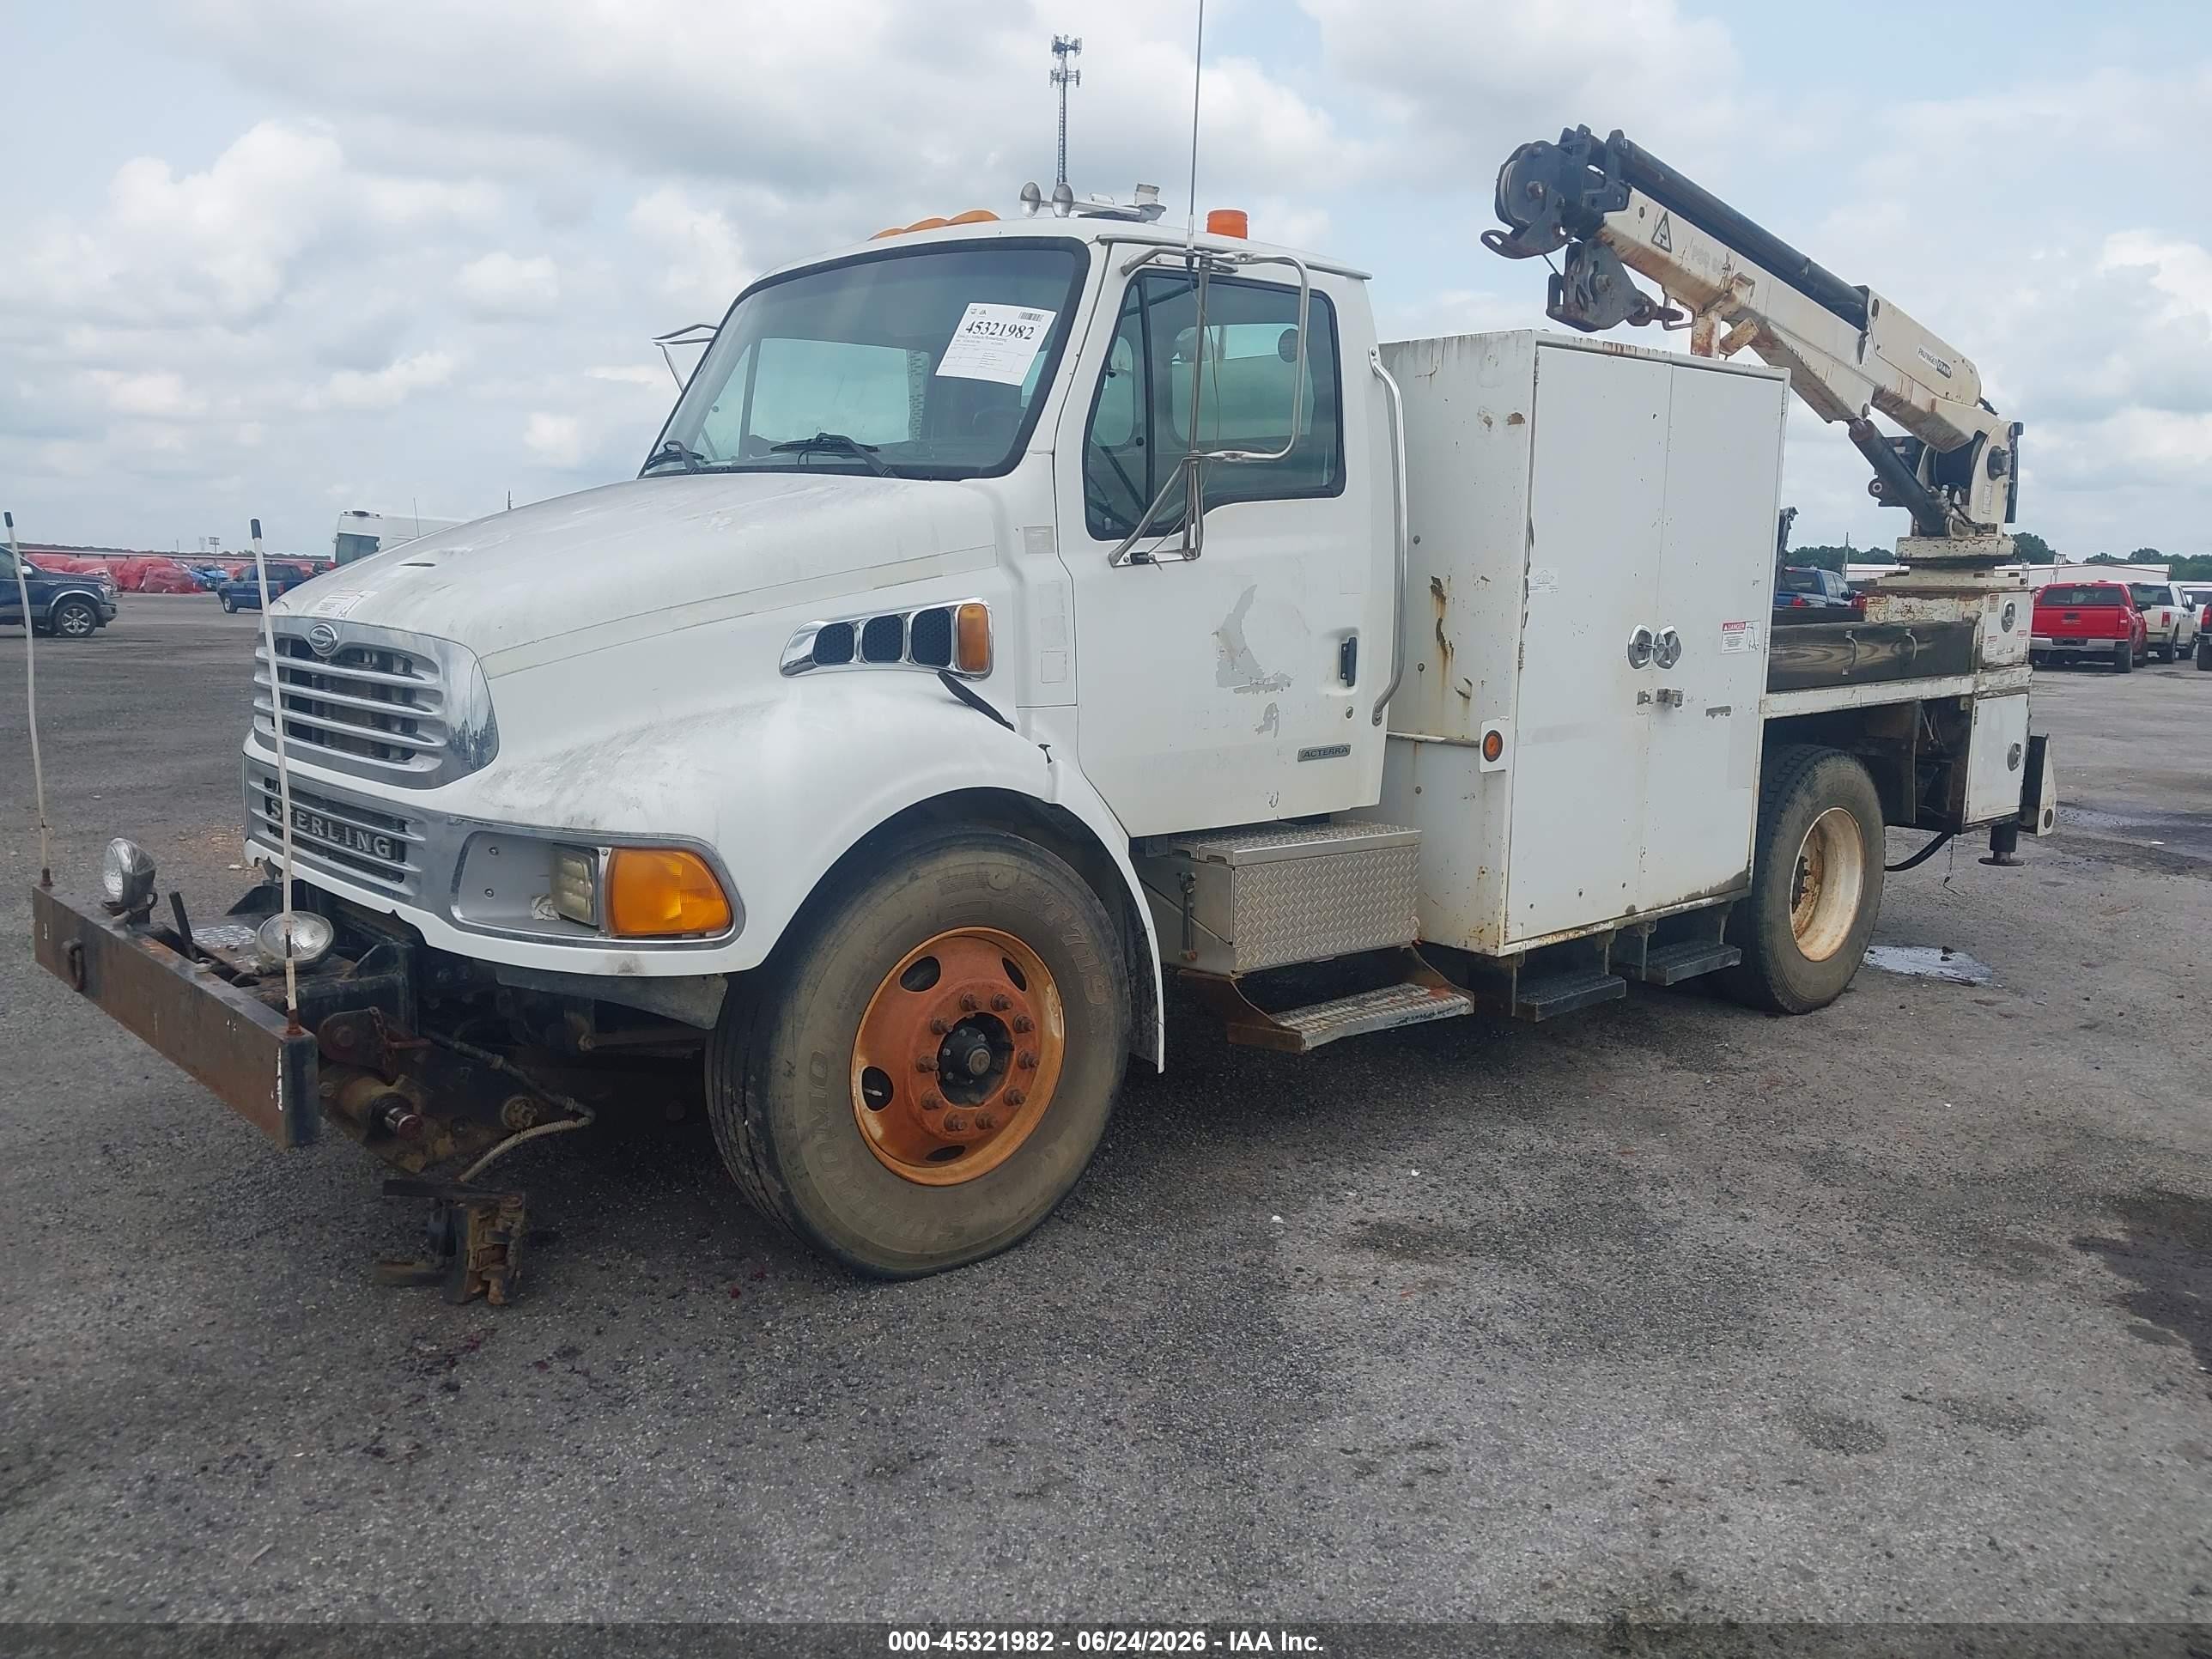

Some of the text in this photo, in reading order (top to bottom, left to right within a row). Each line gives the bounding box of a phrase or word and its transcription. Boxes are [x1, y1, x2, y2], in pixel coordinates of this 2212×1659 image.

[965, 319, 1035, 340] 45321982
[1303, 746, 1349, 758] ACTERRA
[270, 799, 392, 859] SERLING
